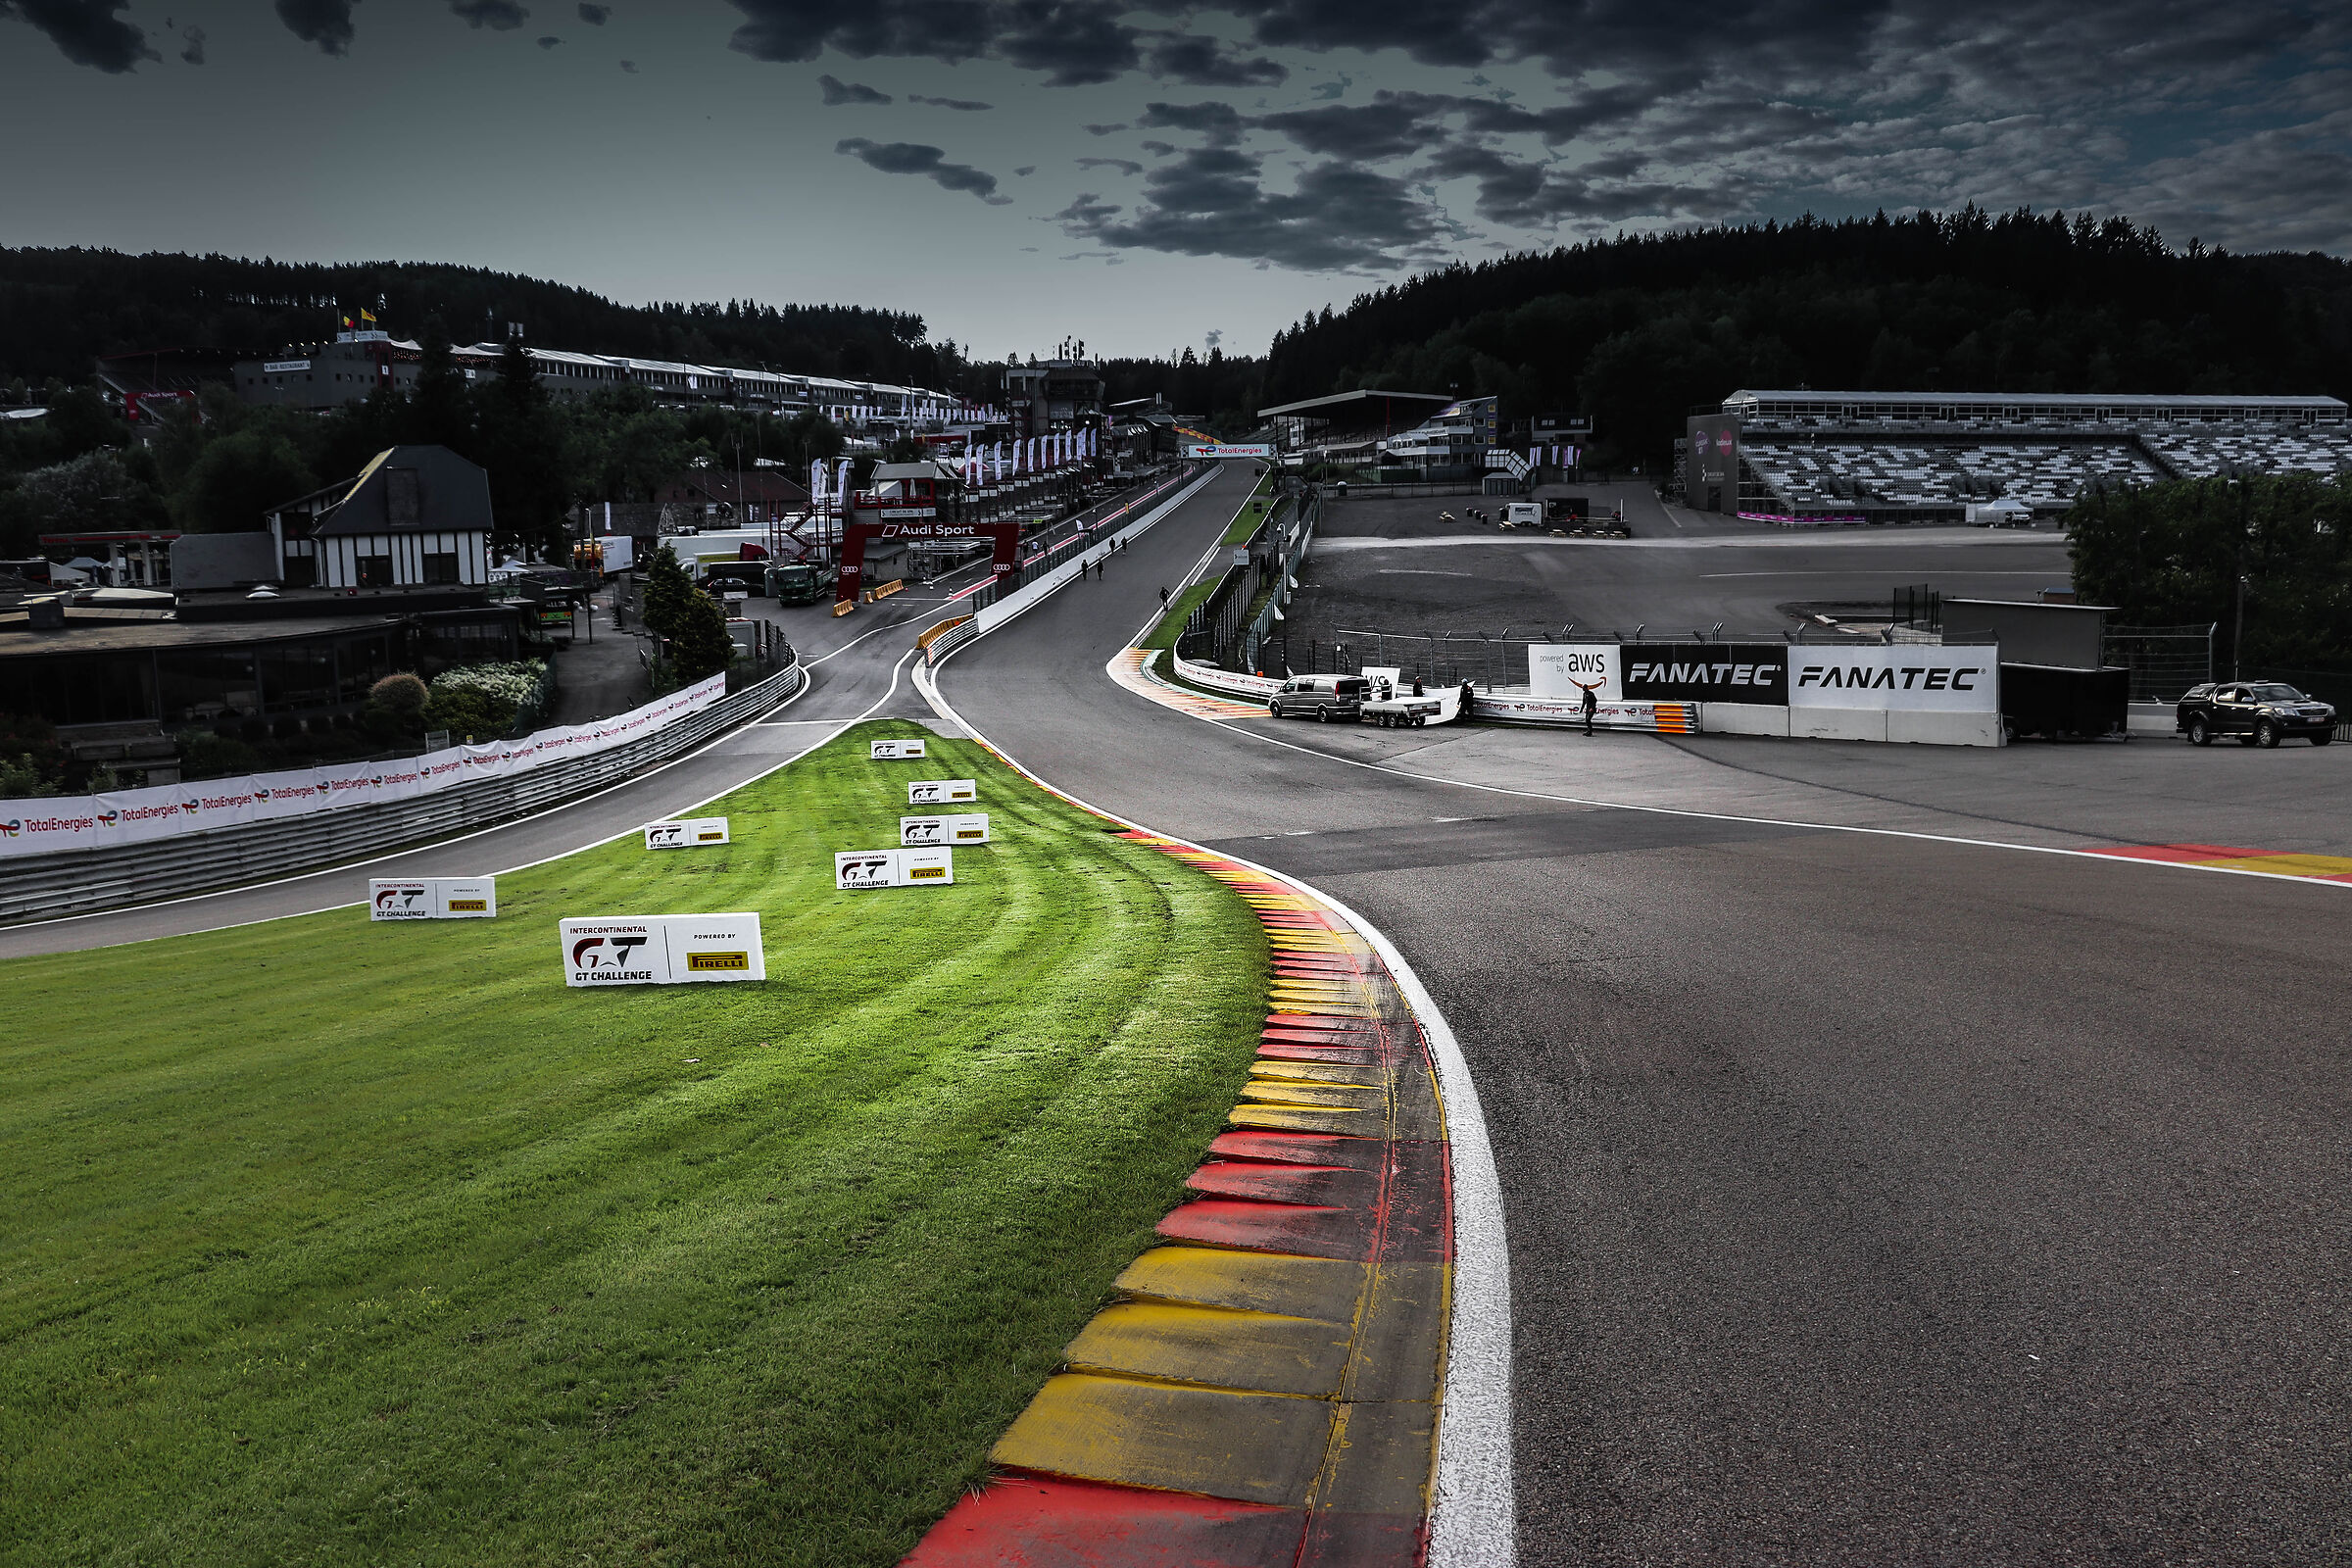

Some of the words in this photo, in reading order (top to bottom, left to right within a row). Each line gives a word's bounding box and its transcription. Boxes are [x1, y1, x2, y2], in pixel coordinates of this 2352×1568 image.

[900, 525, 932, 535] Audi
[935, 525, 975, 537] Sport
[1541, 654, 1564, 663] powered
[1568, 653, 1605, 673] aws
[1556, 664, 1564, 674] by
[1629, 663, 1777, 686] FANATEC
[1798, 666, 1980, 691] FANATEC
[1526, 704, 1563, 714] TotalEnergies
[431, 760, 461, 775] TotalEnergies
[331, 777, 369, 791] TotalEnergies
[383, 772, 417, 785] TotalEnergies
[270, 785, 315, 800] TotalEnergies
[202, 793, 252, 809] TotalEnergies
[121, 803, 178, 821] TotalEnergies
[24, 815, 93, 833] TotalEnergies
[905, 824, 941, 839] GT
[650, 828, 682, 843] GT
[841, 860, 888, 881] GT
[911, 868, 943, 878] PIRELLI
[375, 890, 425, 909] GT
[451, 901, 484, 909] PIRELLI
[569, 925, 648, 935] INTERCONTINENTAL
[572, 936, 649, 969] GT
[691, 955, 744, 968] PIRELLI
[574, 971, 590, 981] GT
[591, 971, 653, 981] CHALLENGE
